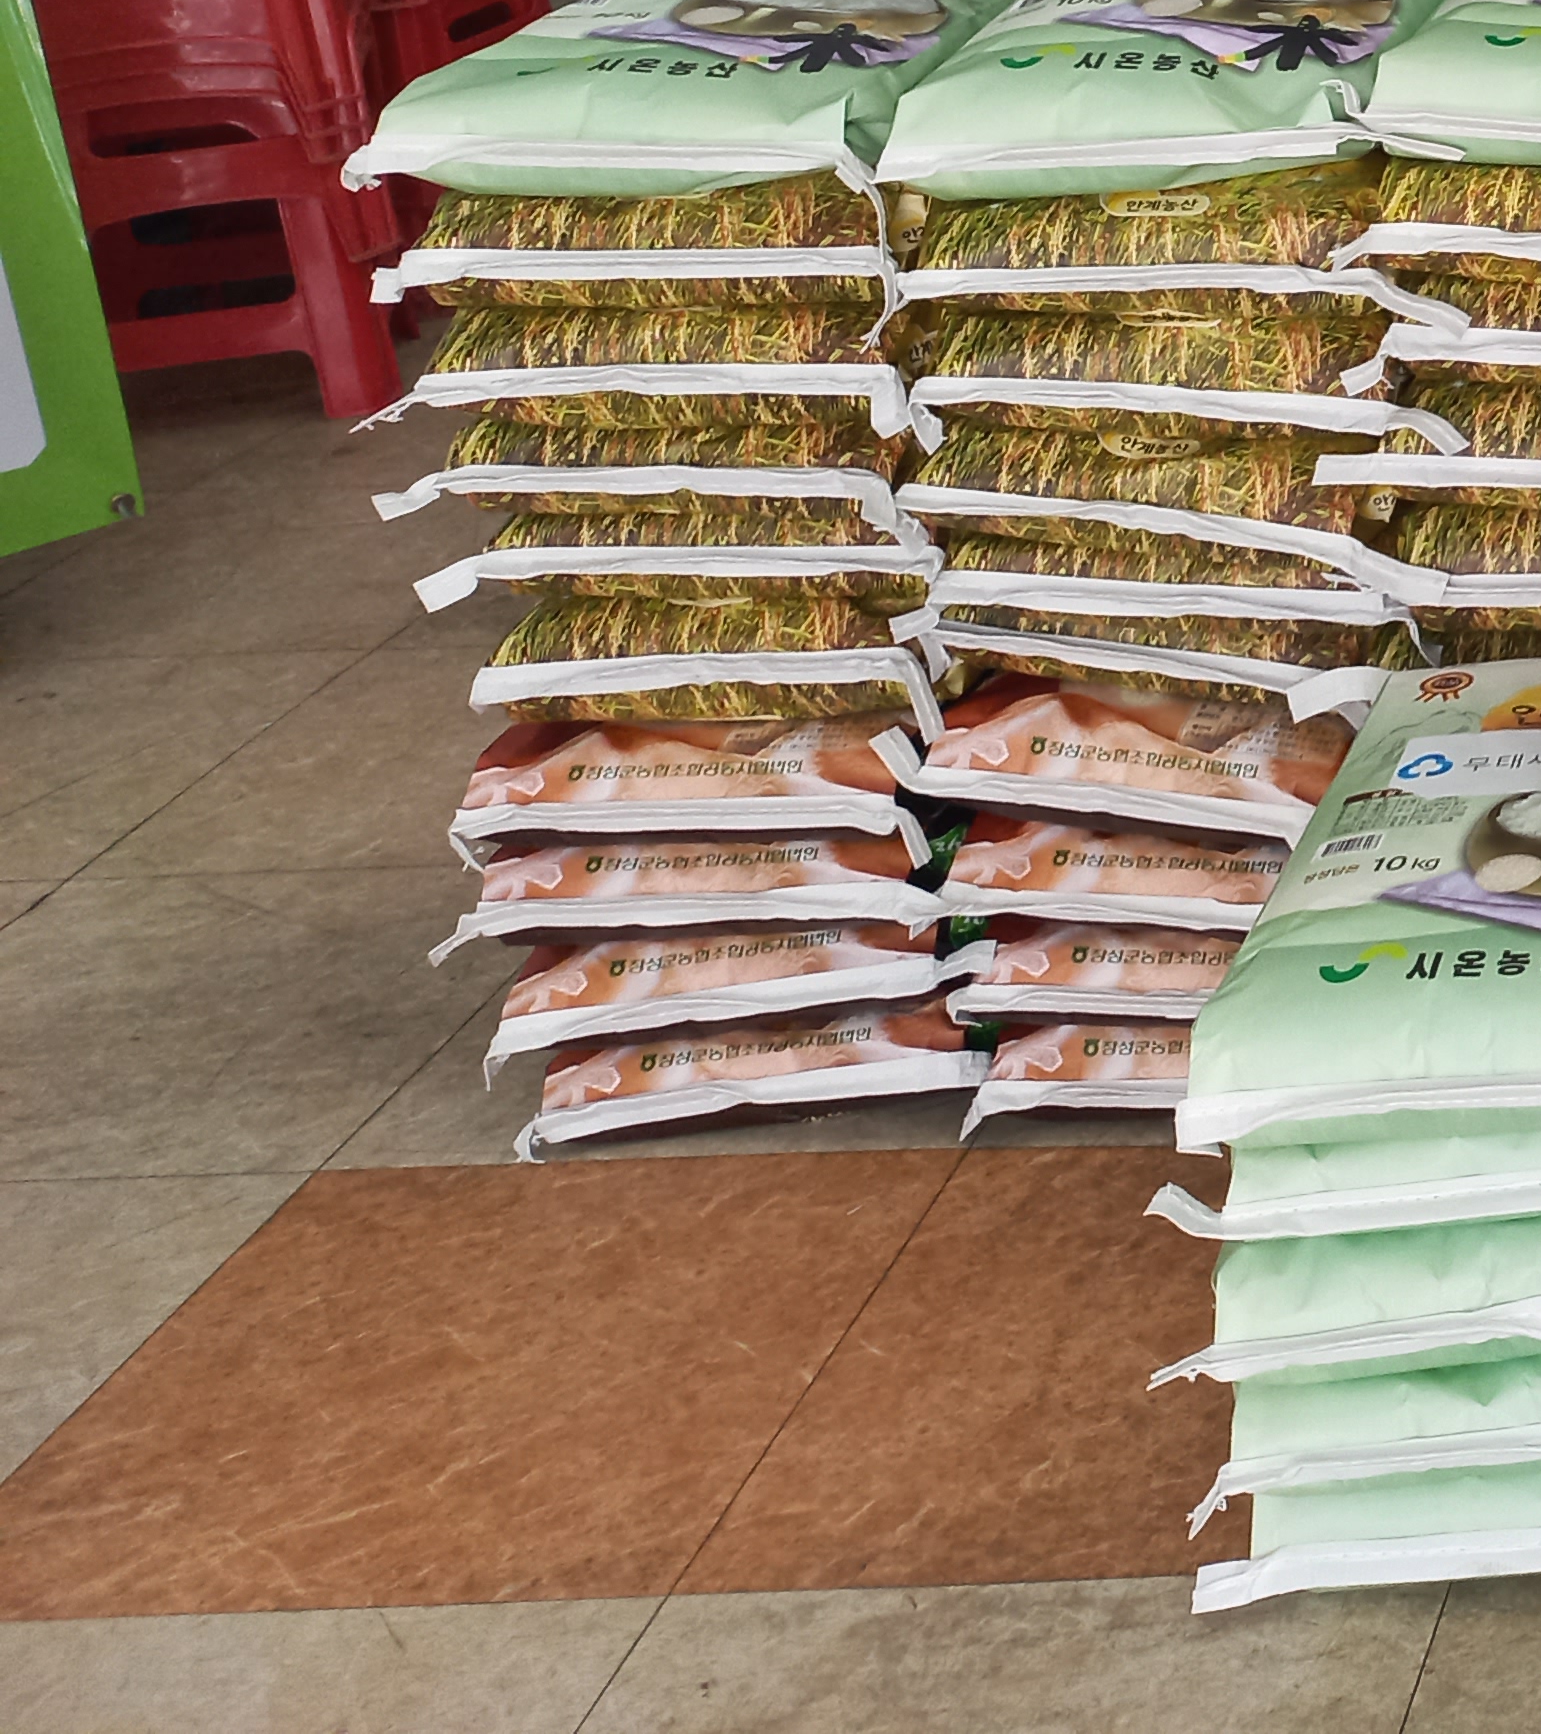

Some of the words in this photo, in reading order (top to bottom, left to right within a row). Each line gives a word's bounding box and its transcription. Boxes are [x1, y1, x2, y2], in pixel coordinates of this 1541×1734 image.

[587, 56, 738, 79] 시온농산
[1074, 50, 1220, 80] 시온농산
[1126, 199, 1198, 213] 안계농산
[1374, 856, 1407, 872] 10
[1411, 857, 1441, 871] kg
